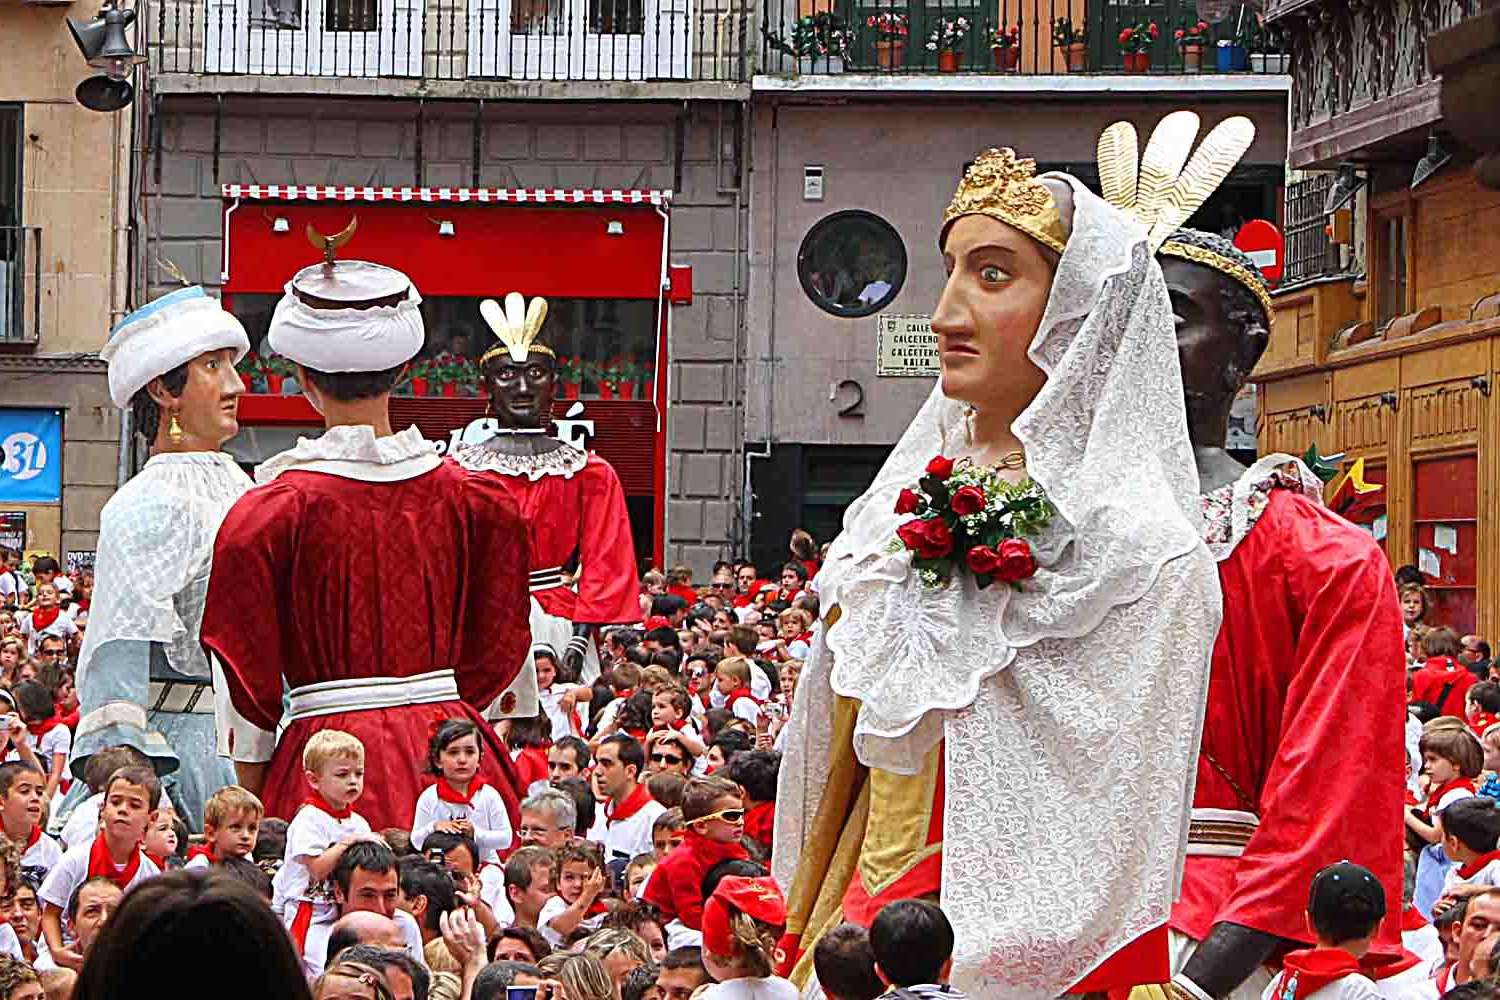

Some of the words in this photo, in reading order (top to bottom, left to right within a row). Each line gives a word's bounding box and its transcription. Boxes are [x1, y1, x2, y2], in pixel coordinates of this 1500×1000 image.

[906, 323, 931, 333] CALLE
[893, 335, 939, 344] CALCETERO
[891, 348, 940, 357] CALCETERO
[837, 380, 865, 417] 2
